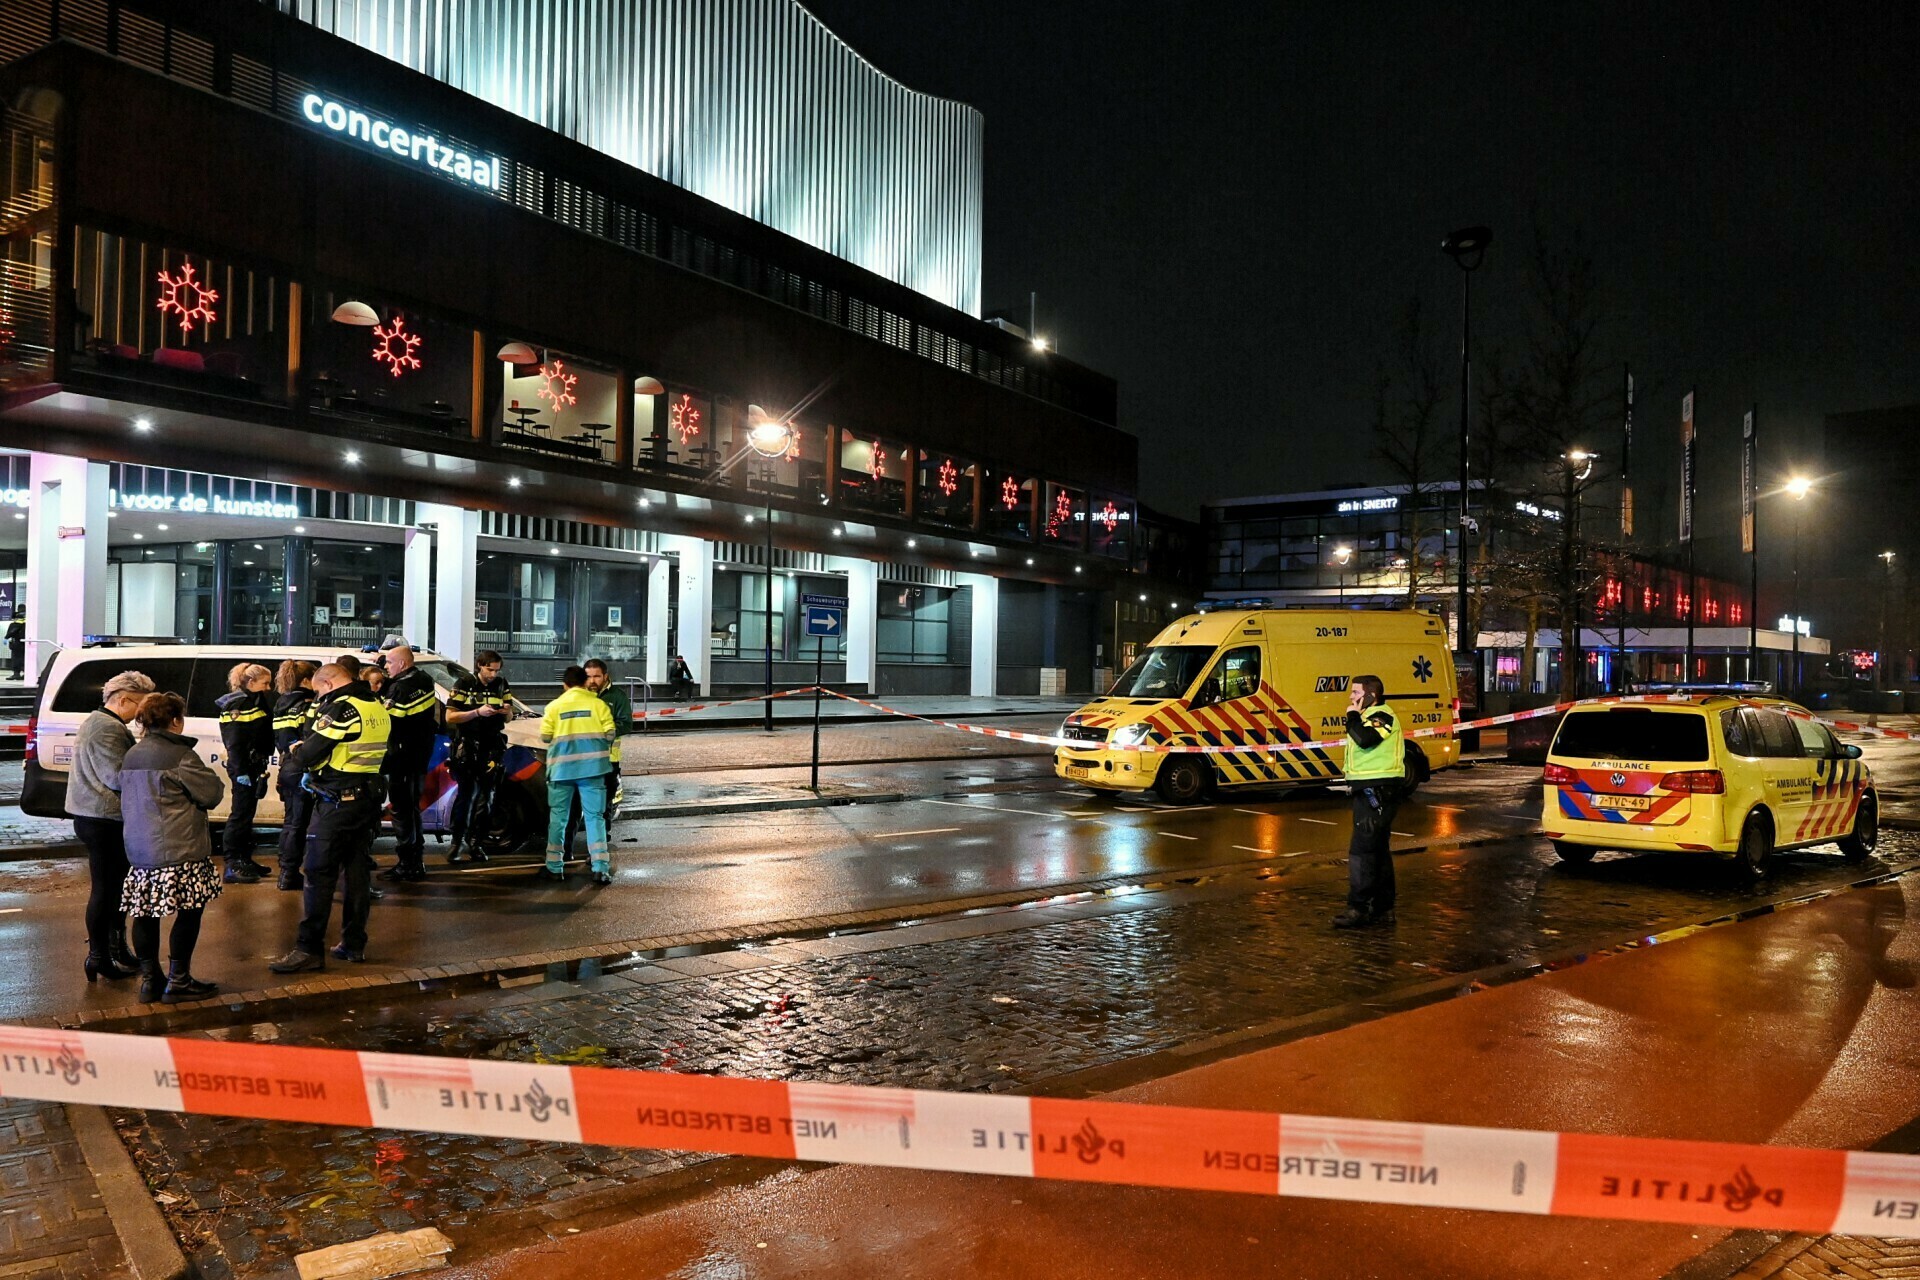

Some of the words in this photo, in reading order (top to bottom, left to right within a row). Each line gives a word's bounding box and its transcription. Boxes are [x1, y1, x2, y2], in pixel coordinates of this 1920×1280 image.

[303, 94, 500, 190] concertzaal
[121, 493, 174, 510] voor
[179, 492, 208, 512] de
[213, 494, 299, 518] kunsten
[1338, 501, 1352, 511] zin
[1363, 497, 1398, 510] SNERT?
[1315, 627, 1348, 637] 20-187
[1315, 676, 1349, 692] RAV
[1412, 714, 1442, 723] 20-187
[1591, 761, 1650, 770] AMBULANCE
[1776, 776, 1812, 788] AMBULANCE
